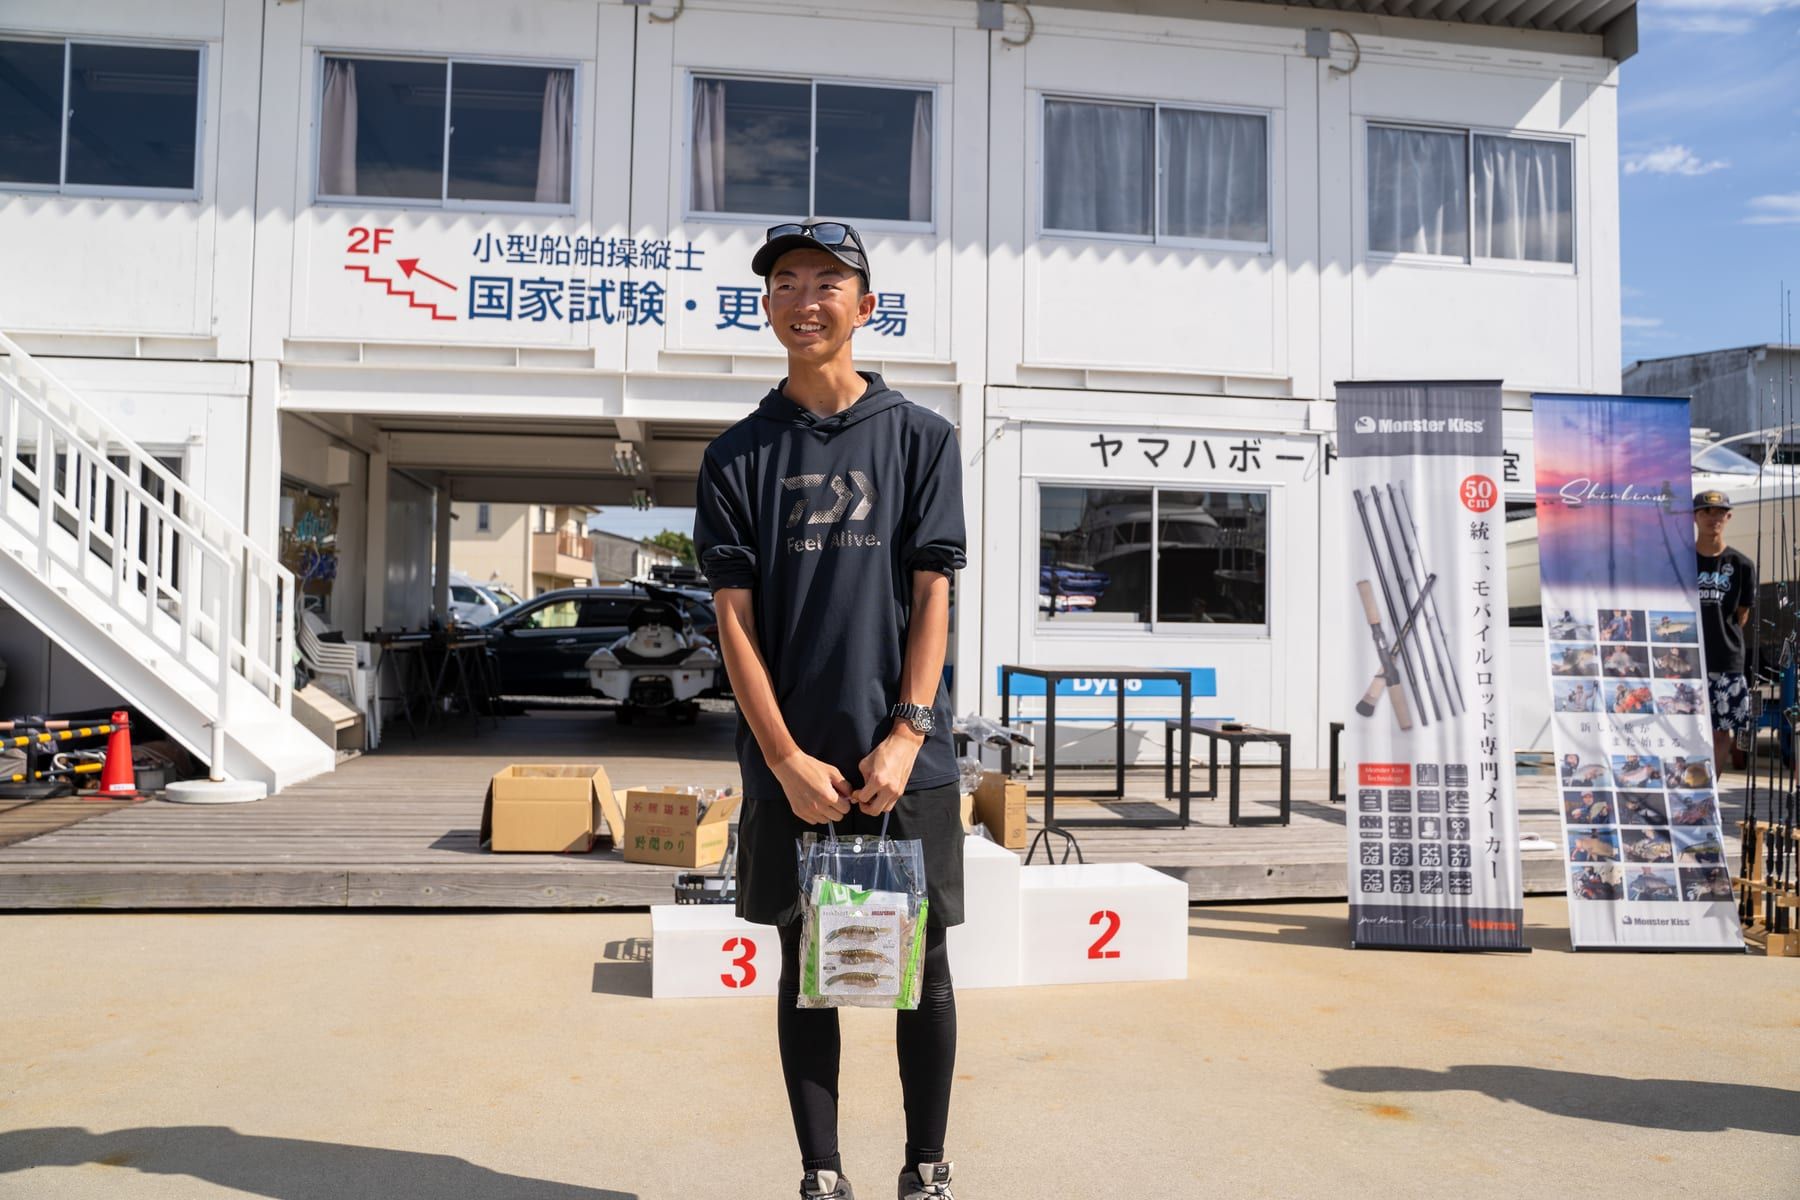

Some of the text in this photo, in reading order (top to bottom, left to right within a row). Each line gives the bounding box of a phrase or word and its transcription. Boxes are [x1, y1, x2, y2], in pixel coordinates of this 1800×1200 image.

[346, 226, 394, 254] 2F
[472, 232, 705, 272] 小型船舶操縦士
[468, 274, 909, 338] 国家試験・更場
[1378, 418, 1484, 433] Monster Kiss
[1464, 480, 1493, 499] 50
[1467, 499, 1490, 509] cm
[786, 533, 823, 554] Feel
[1634, 918, 1690, 926] Monster Kiss
[1088, 910, 1120, 959] 2
[721, 937, 757, 988] 3
